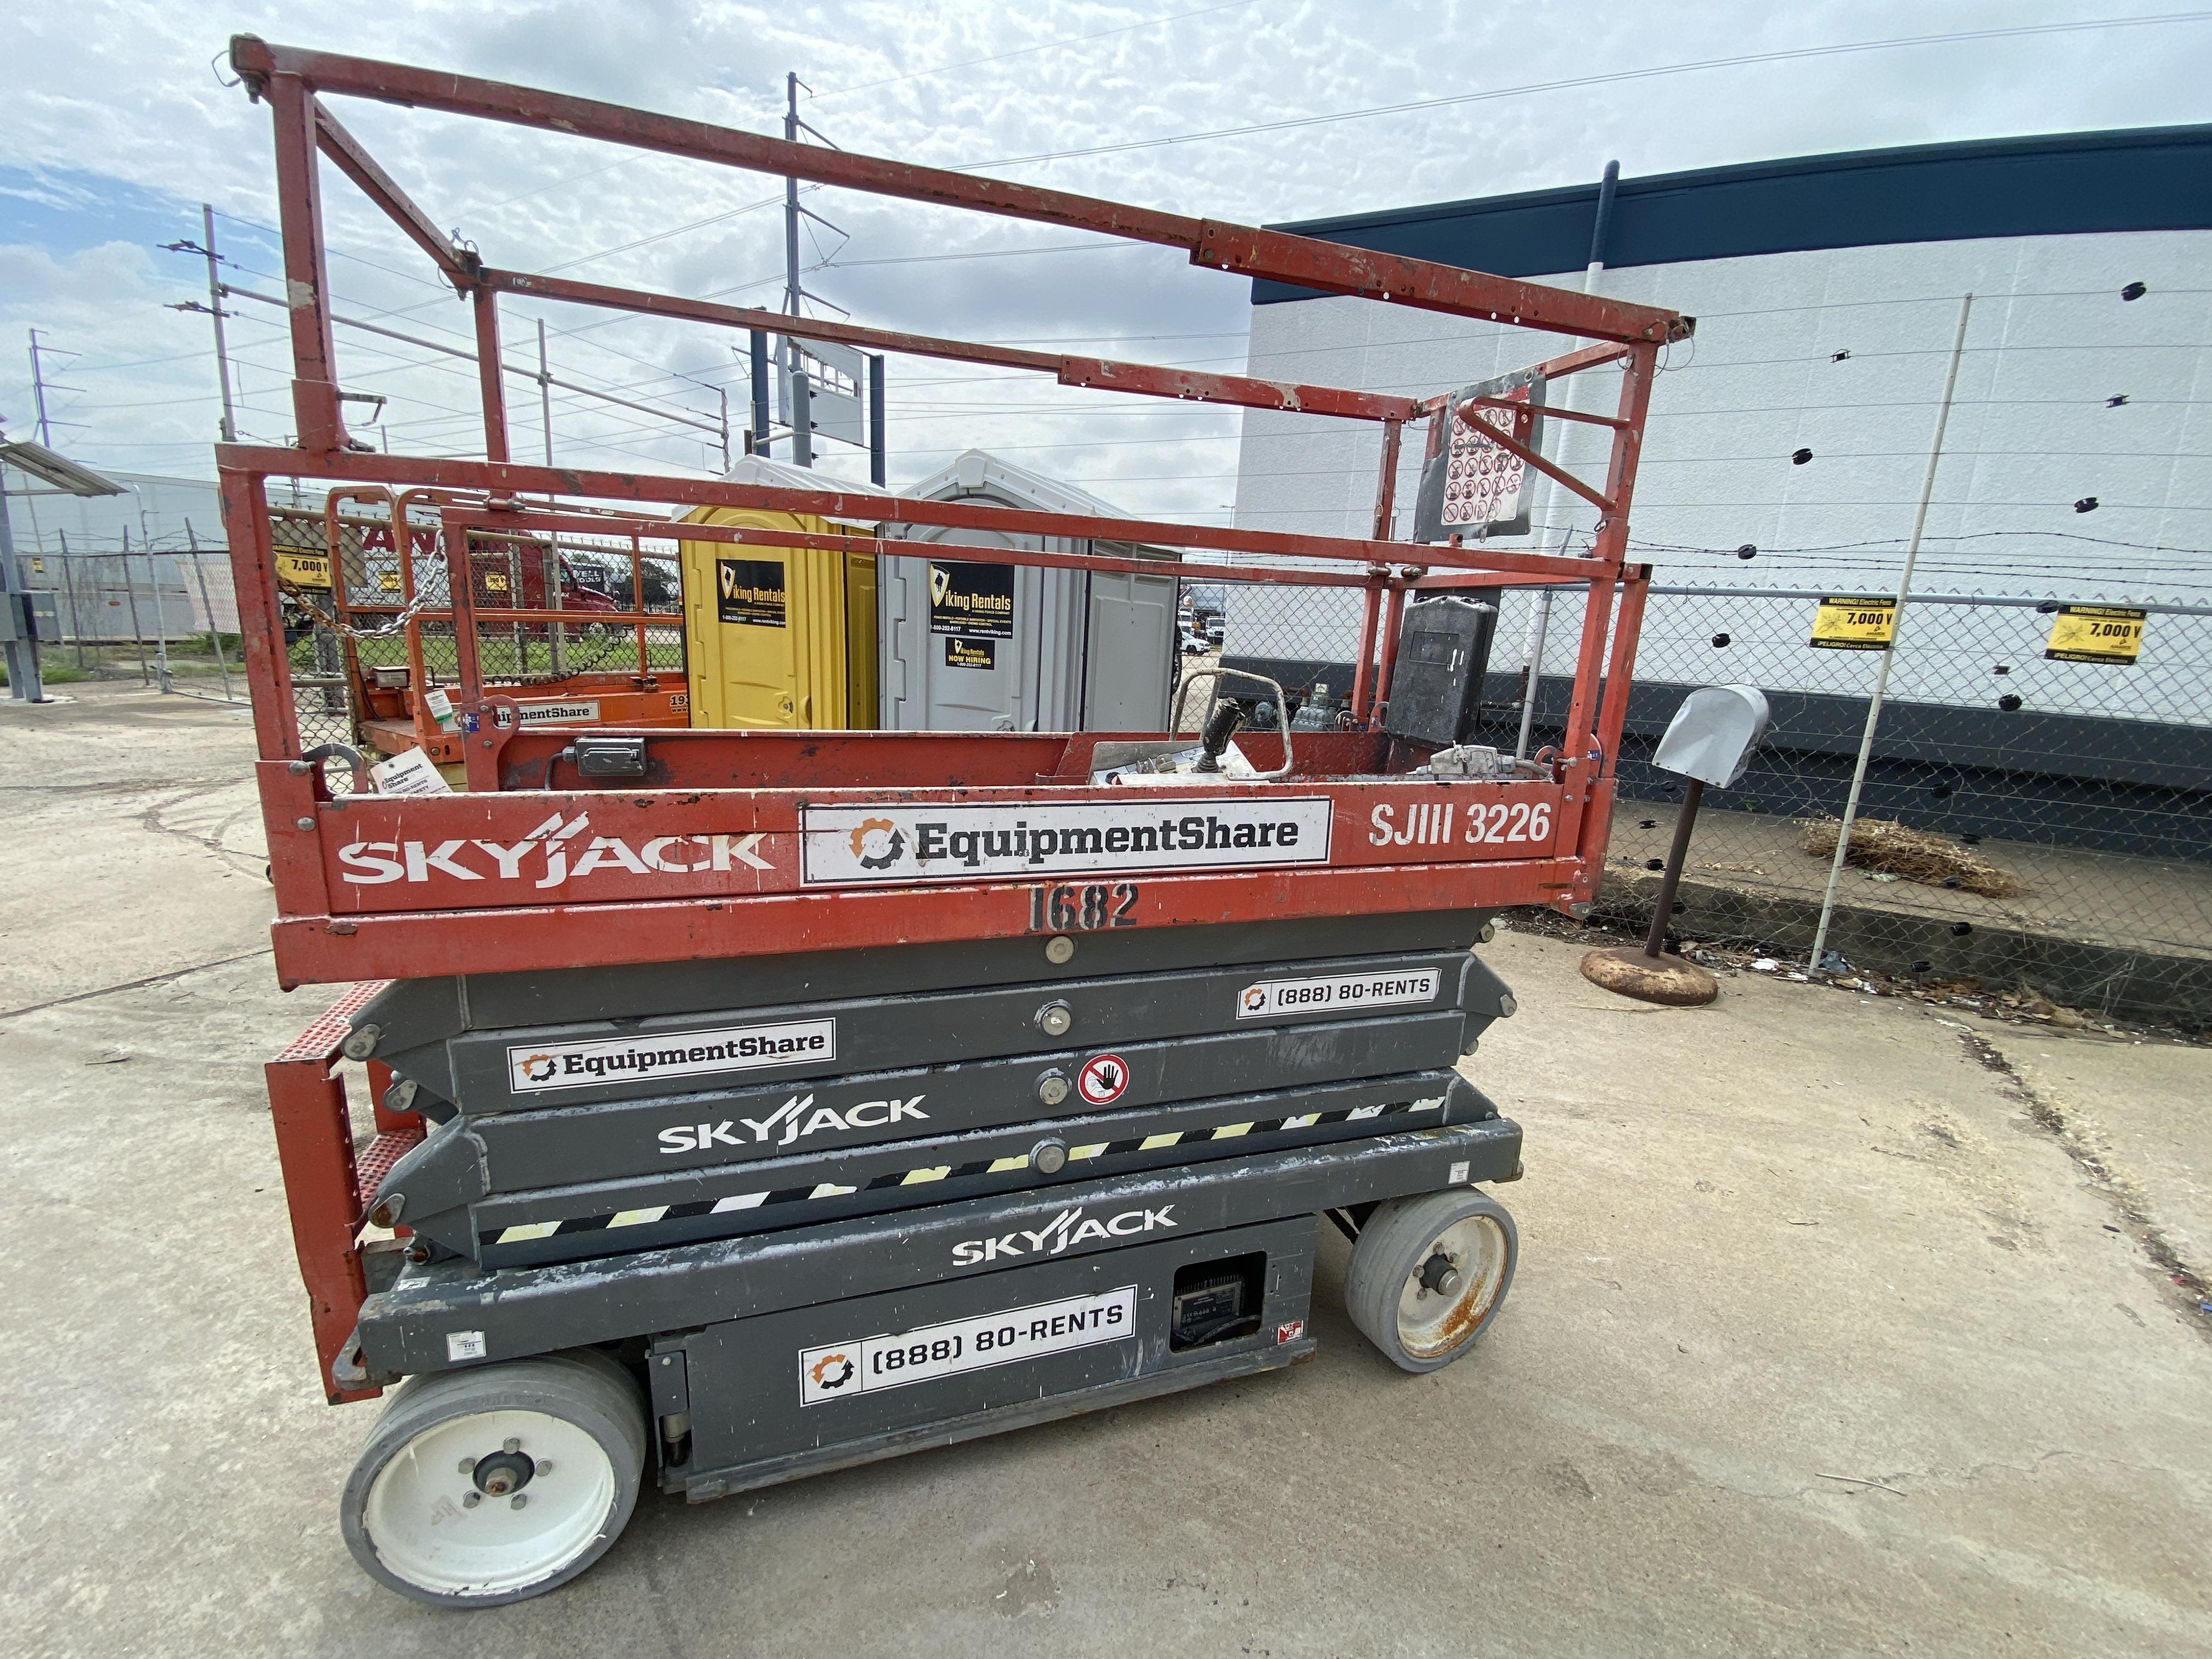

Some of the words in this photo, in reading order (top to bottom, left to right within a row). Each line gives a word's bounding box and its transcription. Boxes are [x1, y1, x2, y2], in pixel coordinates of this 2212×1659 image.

[291, 558, 322, 572] 7,000
[753, 587, 786, 602] Rentals
[971, 593, 1011, 610] Rentals
[1847, 612, 1883, 625] 7,000
[1886, 613, 1893, 625] V
[2090, 623, 2131, 637] 7,000
[2134, 626, 2141, 638] V
[966, 656, 991, 664] HIRING
[385, 763, 423, 785] Equipment
[387, 776, 409, 789] Share
[413, 785, 429, 794] AFETY
[1465, 802, 1551, 844] 3226
[337, 810, 776, 889] SKYJACK
[916, 816, 1299, 867] EquipmentShare
[1029, 883, 1138, 932] 1682
[1278, 988, 1331, 1006] (888)
[1339, 978, 1430, 1000] 80-RENTS
[563, 1032, 825, 1077] EquipmentShare
[658, 1093, 931, 1154] SKYJACK
[952, 1204, 1178, 1266] SKYJACK
[873, 1336, 962, 1374] (888)
[975, 1304, 1122, 1351] 80-RENTS
